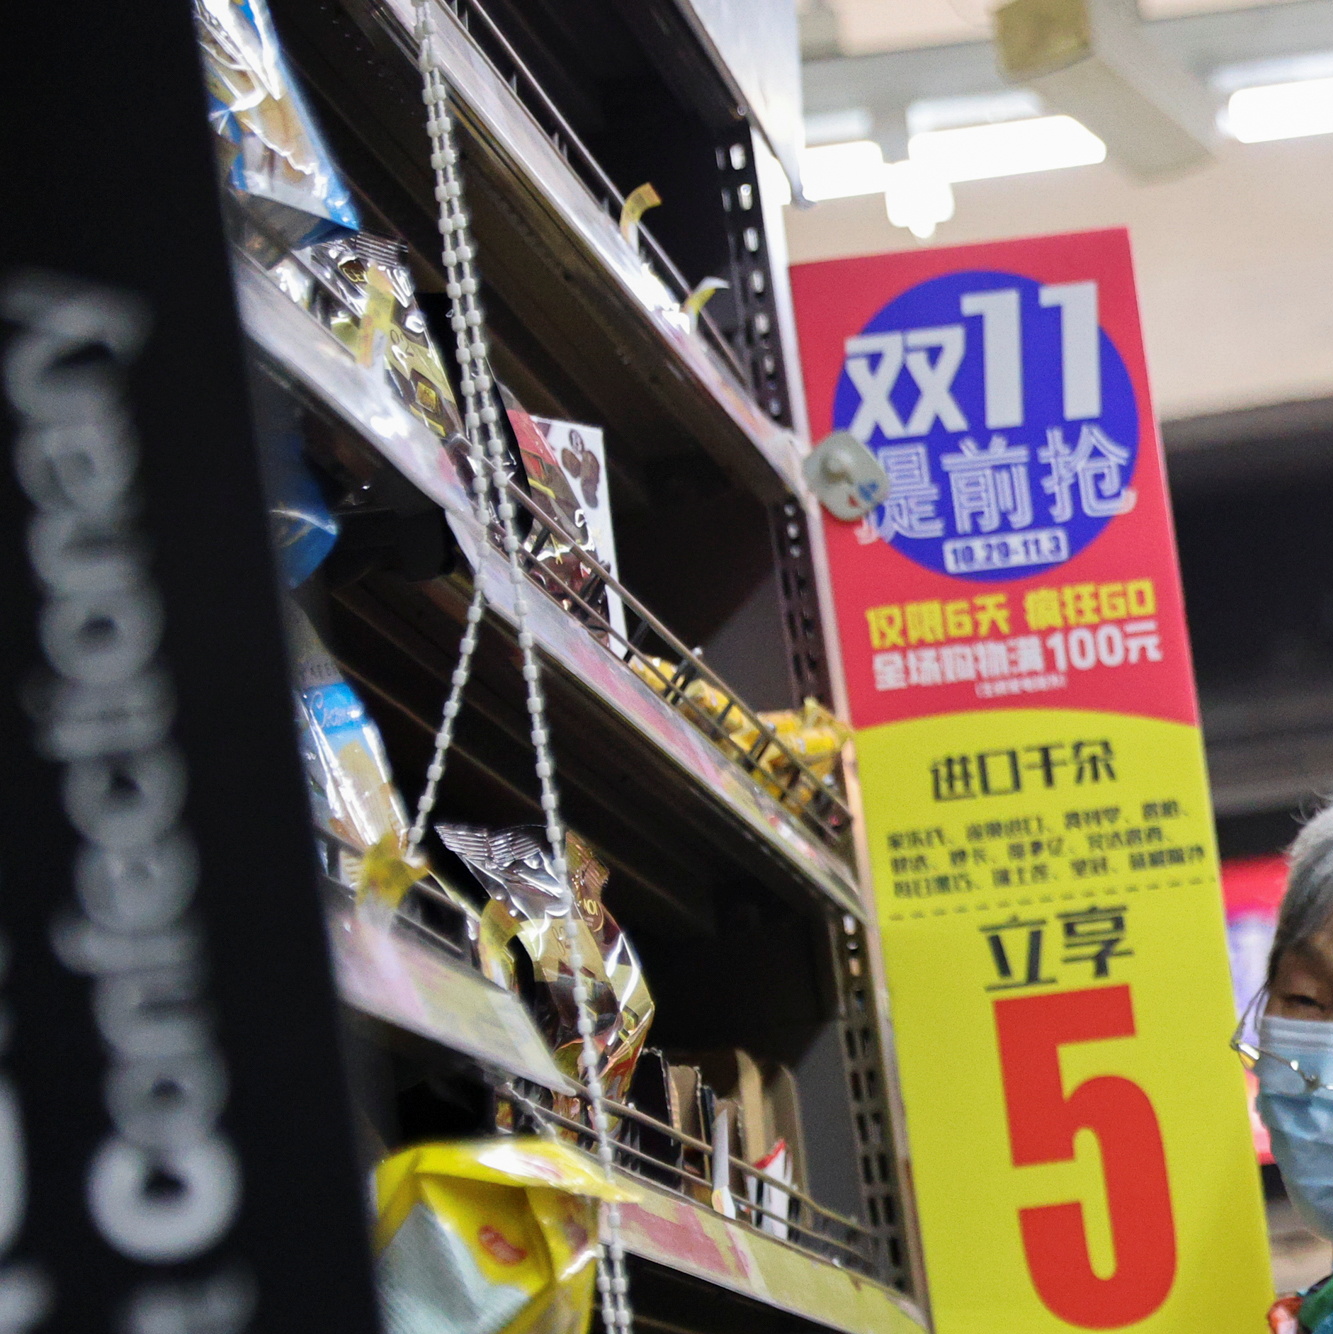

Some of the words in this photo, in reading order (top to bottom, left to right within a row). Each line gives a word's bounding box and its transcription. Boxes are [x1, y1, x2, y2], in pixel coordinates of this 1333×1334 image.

[845, 280, 1101, 442] 双11
[979, 905, 1135, 991] 立享
[992, 983, 1178, 1330] 5
